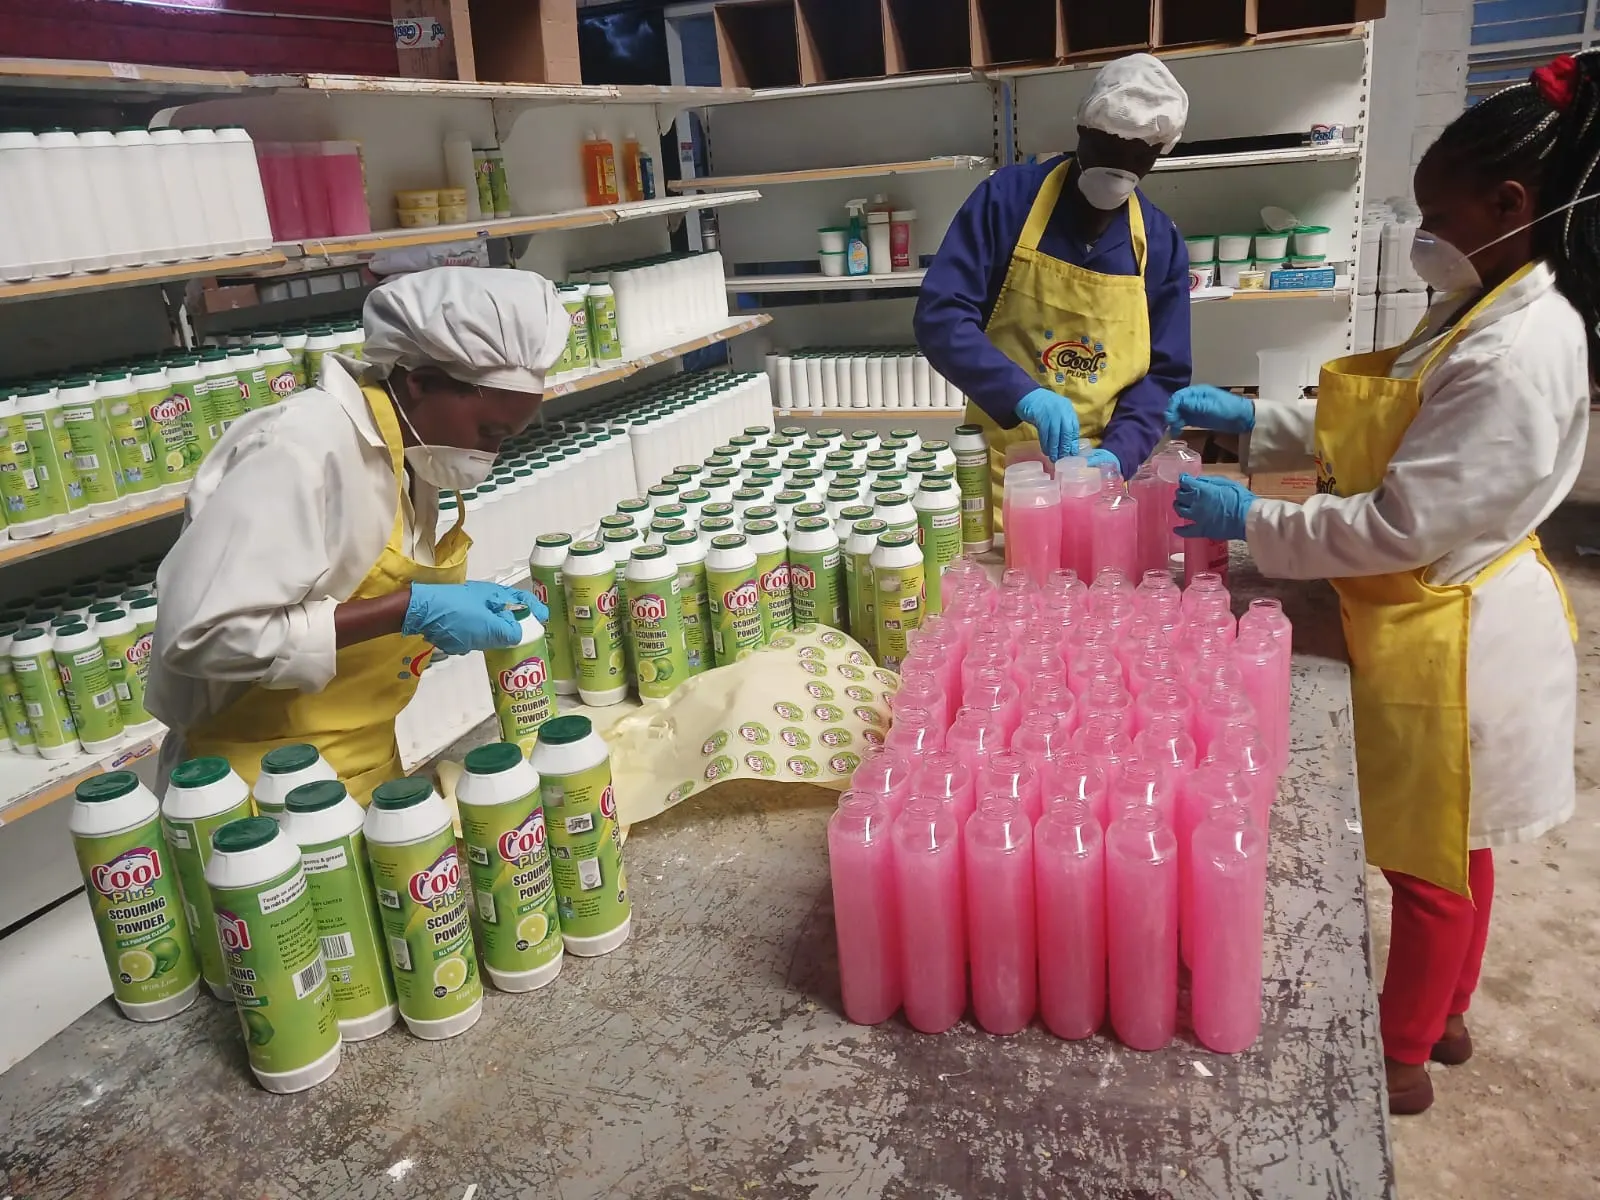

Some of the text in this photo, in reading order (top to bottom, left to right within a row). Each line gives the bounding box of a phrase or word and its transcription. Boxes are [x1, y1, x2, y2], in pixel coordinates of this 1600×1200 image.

[1057, 349, 1107, 372] Cool
[1066, 369, 1087, 379] PLUS
[760, 570, 790, 593] Coo
[791, 570, 816, 590] ool
[629, 597, 667, 620] Cool
[635, 630, 667, 640] SCOURING
[638, 640, 665, 650] POWDER
[498, 659, 548, 693] Cool
[511, 695, 550, 714] SCOURING
[514, 687, 544, 702] Plus
[516, 708, 550, 725] POWDER
[497, 823, 546, 862] Coo
[518, 846, 547, 870] Plus
[91, 850, 162, 894] Cool
[408, 863, 460, 904] Coo
[112, 886, 156, 905] Plus
[431, 888, 464, 913] Plus
[108, 896, 166, 920] SCOURING
[115, 914, 165, 935] POWDER
